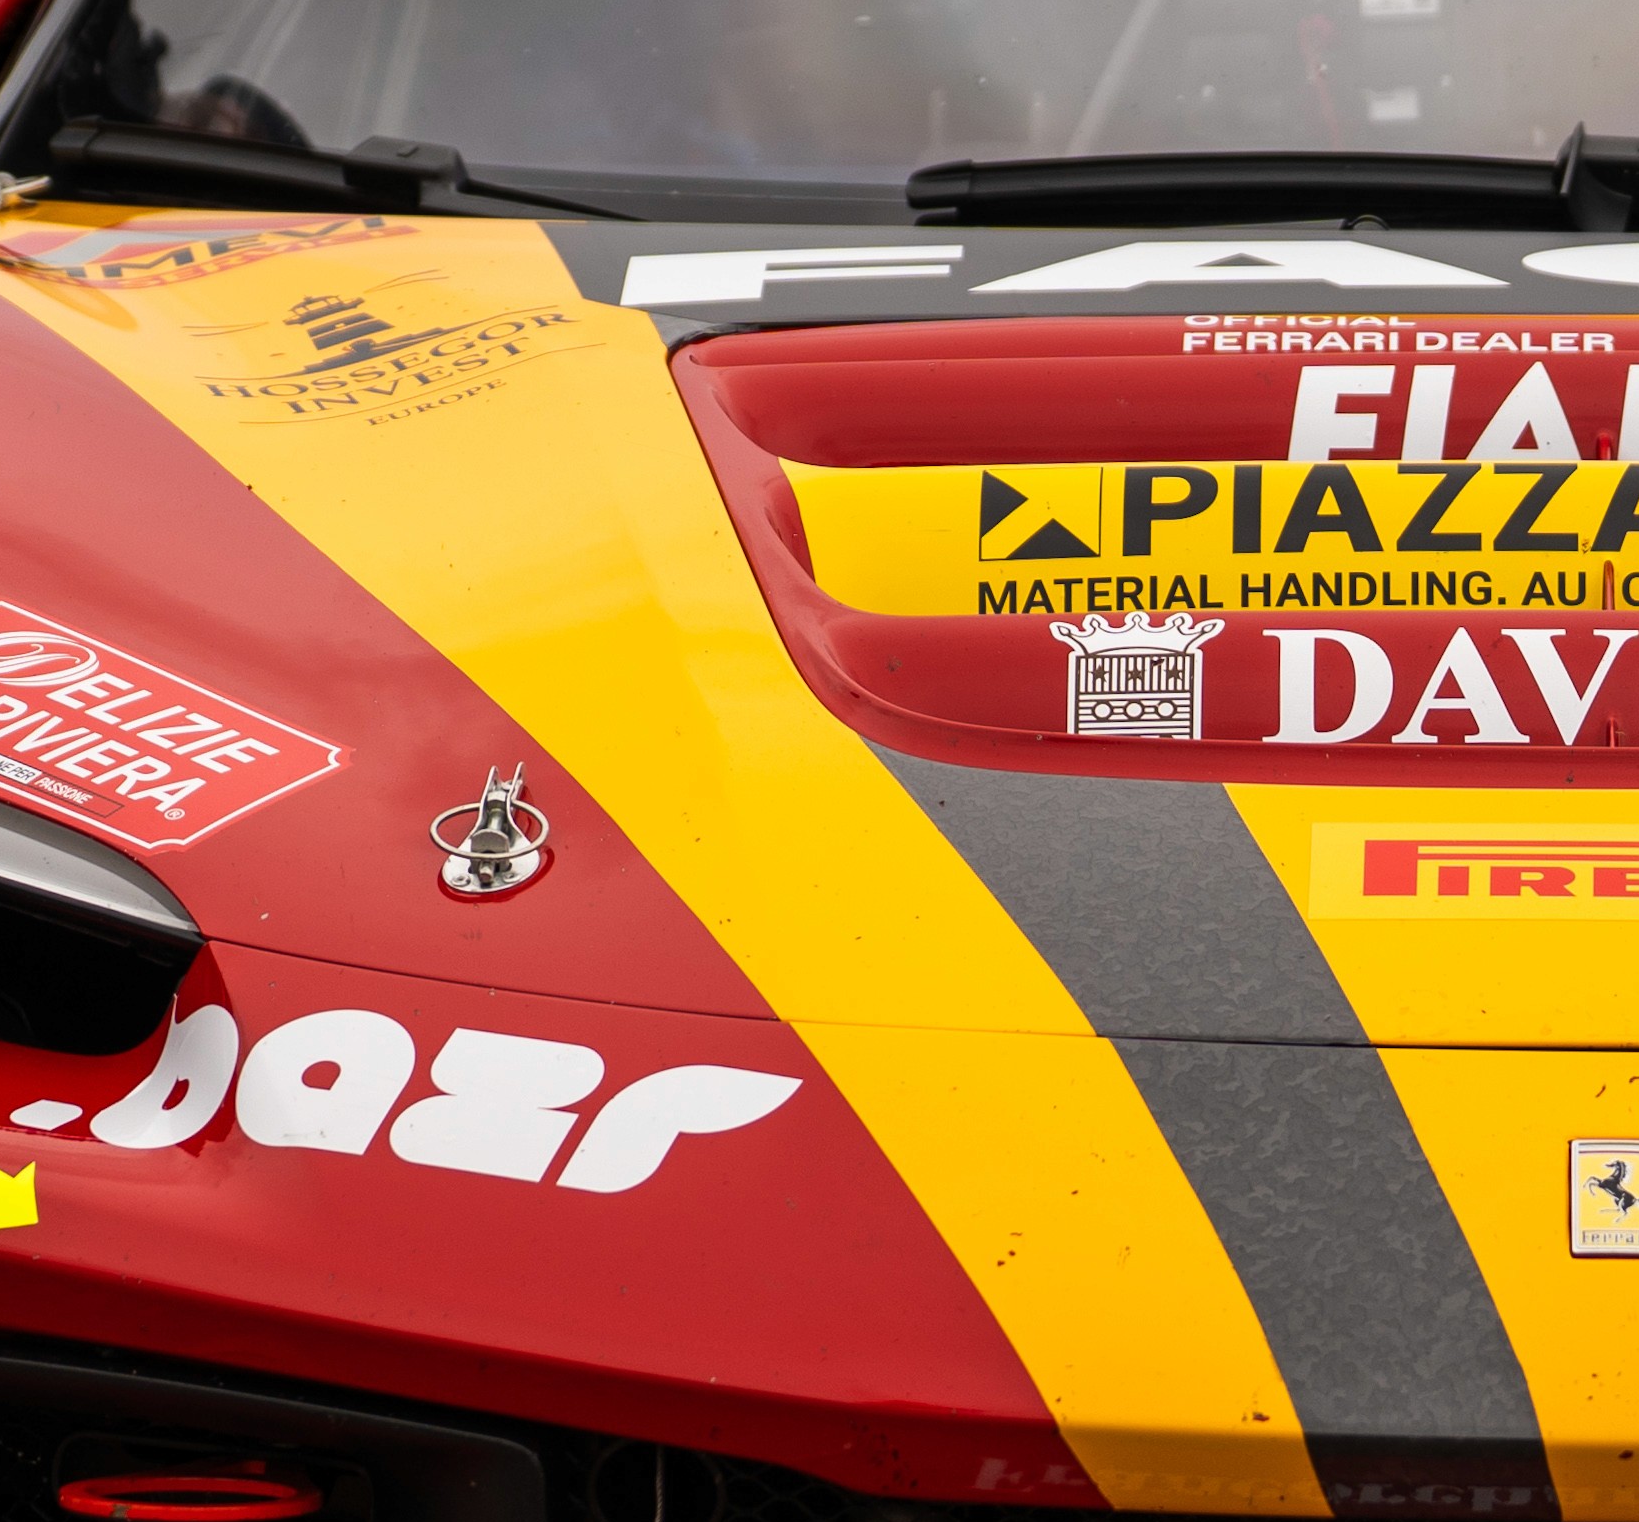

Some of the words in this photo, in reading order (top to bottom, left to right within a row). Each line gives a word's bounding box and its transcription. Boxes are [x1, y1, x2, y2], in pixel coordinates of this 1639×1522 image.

[1181, 330, 1401, 353] FERRARI
[1415, 330, 1616, 353] DEALER
[1183, 315, 1417, 327] OFFICIAL
[201, 311, 581, 399] HOSSEGOR
[281, 336, 531, 415] INVEST
[365, 377, 508, 427] EUROPE
[977, 573, 1225, 615] MATERIAL
[1239, 569, 1513, 608] HANDLING.
[7, 764, 37, 782] PER
[33, 776, 95, 806] PASSIONE
